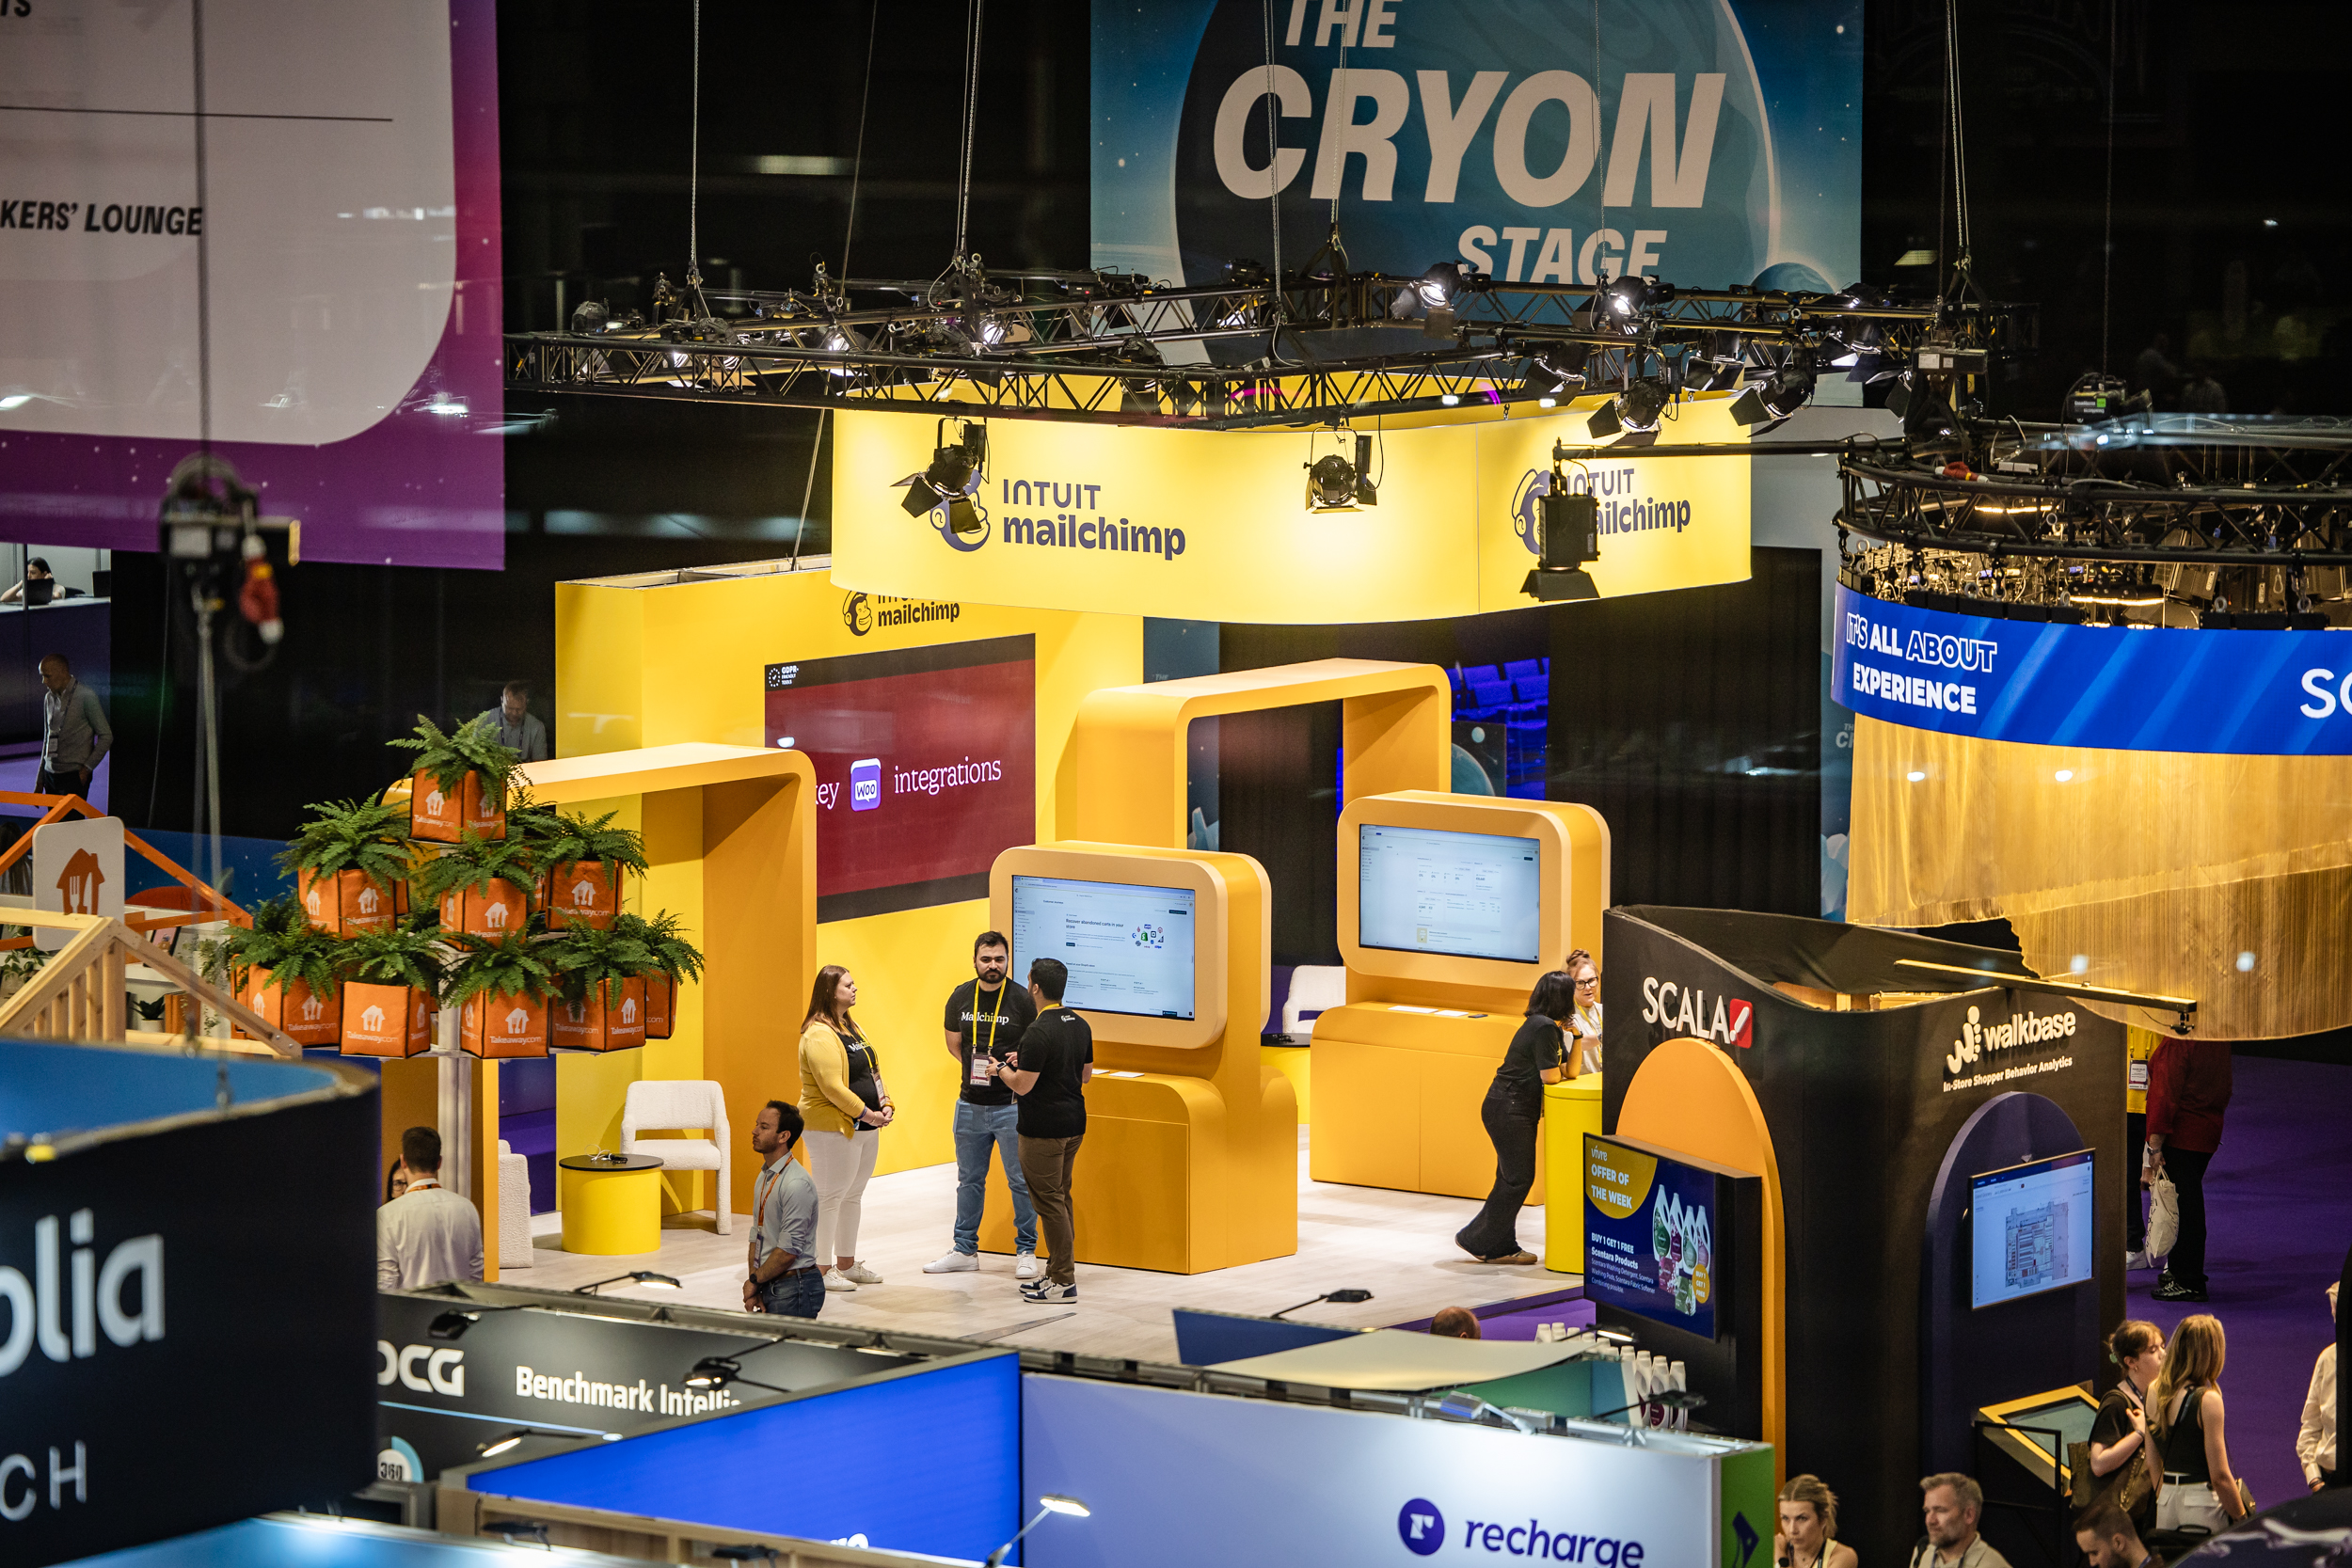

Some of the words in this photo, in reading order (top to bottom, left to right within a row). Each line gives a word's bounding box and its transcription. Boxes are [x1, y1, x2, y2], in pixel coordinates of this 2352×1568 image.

[1285, 0, 1403, 48] THE
[1213, 64, 1726, 208] CRYON
[84, 203, 202, 236] LOUNGE
[1457, 225, 1669, 286] STAGE
[1003, 478, 1101, 510] INTUIT
[1566, 468, 1635, 497] INTUIT
[1597, 497, 1692, 536] ilchimp
[1003, 514, 1186, 561] mailchimp
[878, 601, 960, 626] mailchimp
[1846, 611, 1868, 649] IT'S
[1869, 624, 1903, 657] ALL
[1905, 630, 1997, 673] ABOUT
[1852, 662, 1977, 715] EXPERIENCE
[815, 782, 840, 810] ey
[894, 756, 1002, 796] integrations
[961, 1011, 1009, 1025] Malchimp
[1983, 1011, 2076, 1052] walkbase
[1943, 1077, 1973, 1092] In-Store
[1973, 1070, 2005, 1085] Shopper
[2005, 1063, 2039, 1079] Behavior
[2039, 1055, 2073, 1072] Analytics
[1591, 1164, 1616, 1182] OFFER
[1618, 1172, 1629, 1186] OF
[1591, 1184, 1607, 1201] THE
[1608, 1190, 1632, 1210] WEEK
[1591, 1232, 1602, 1243] BUY
[1603, 1236, 1606, 1245] 1
[1606, 1237, 1617, 1248] GET
[1620, 1242, 1634, 1255] FREE
[1591, 1246, 1614, 1261] Scentara
[1614, 1254, 1639, 1270] Products
[516, 1365, 655, 1413] Benchmark
[660, 1384, 741, 1416] Intelli
[380, 1462, 403, 1481] 360
[1465, 1518, 1645, 1568] recharge
